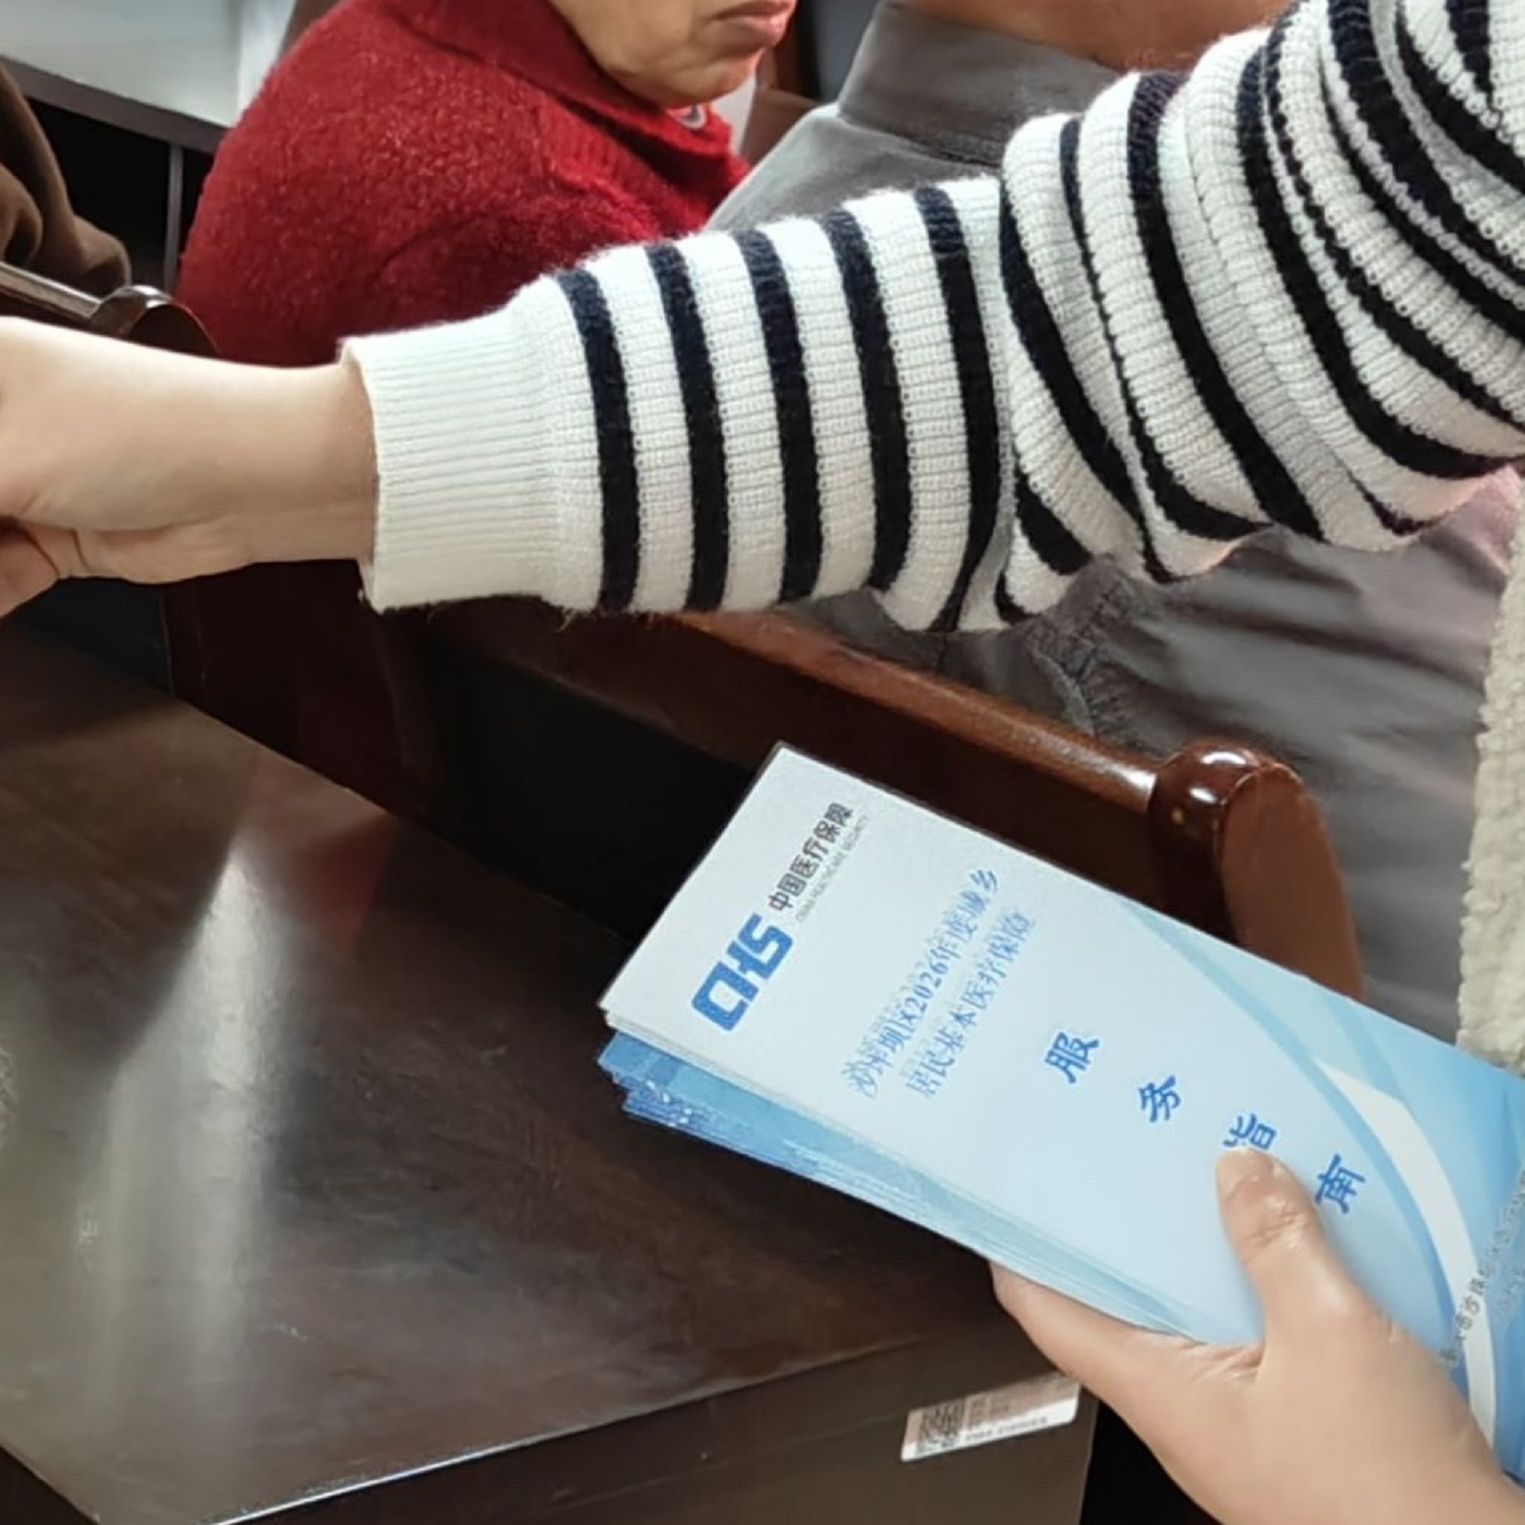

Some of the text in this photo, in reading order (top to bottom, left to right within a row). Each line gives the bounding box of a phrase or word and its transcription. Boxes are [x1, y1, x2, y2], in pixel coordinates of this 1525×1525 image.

[767, 802, 853, 913] 中国医疗保障
